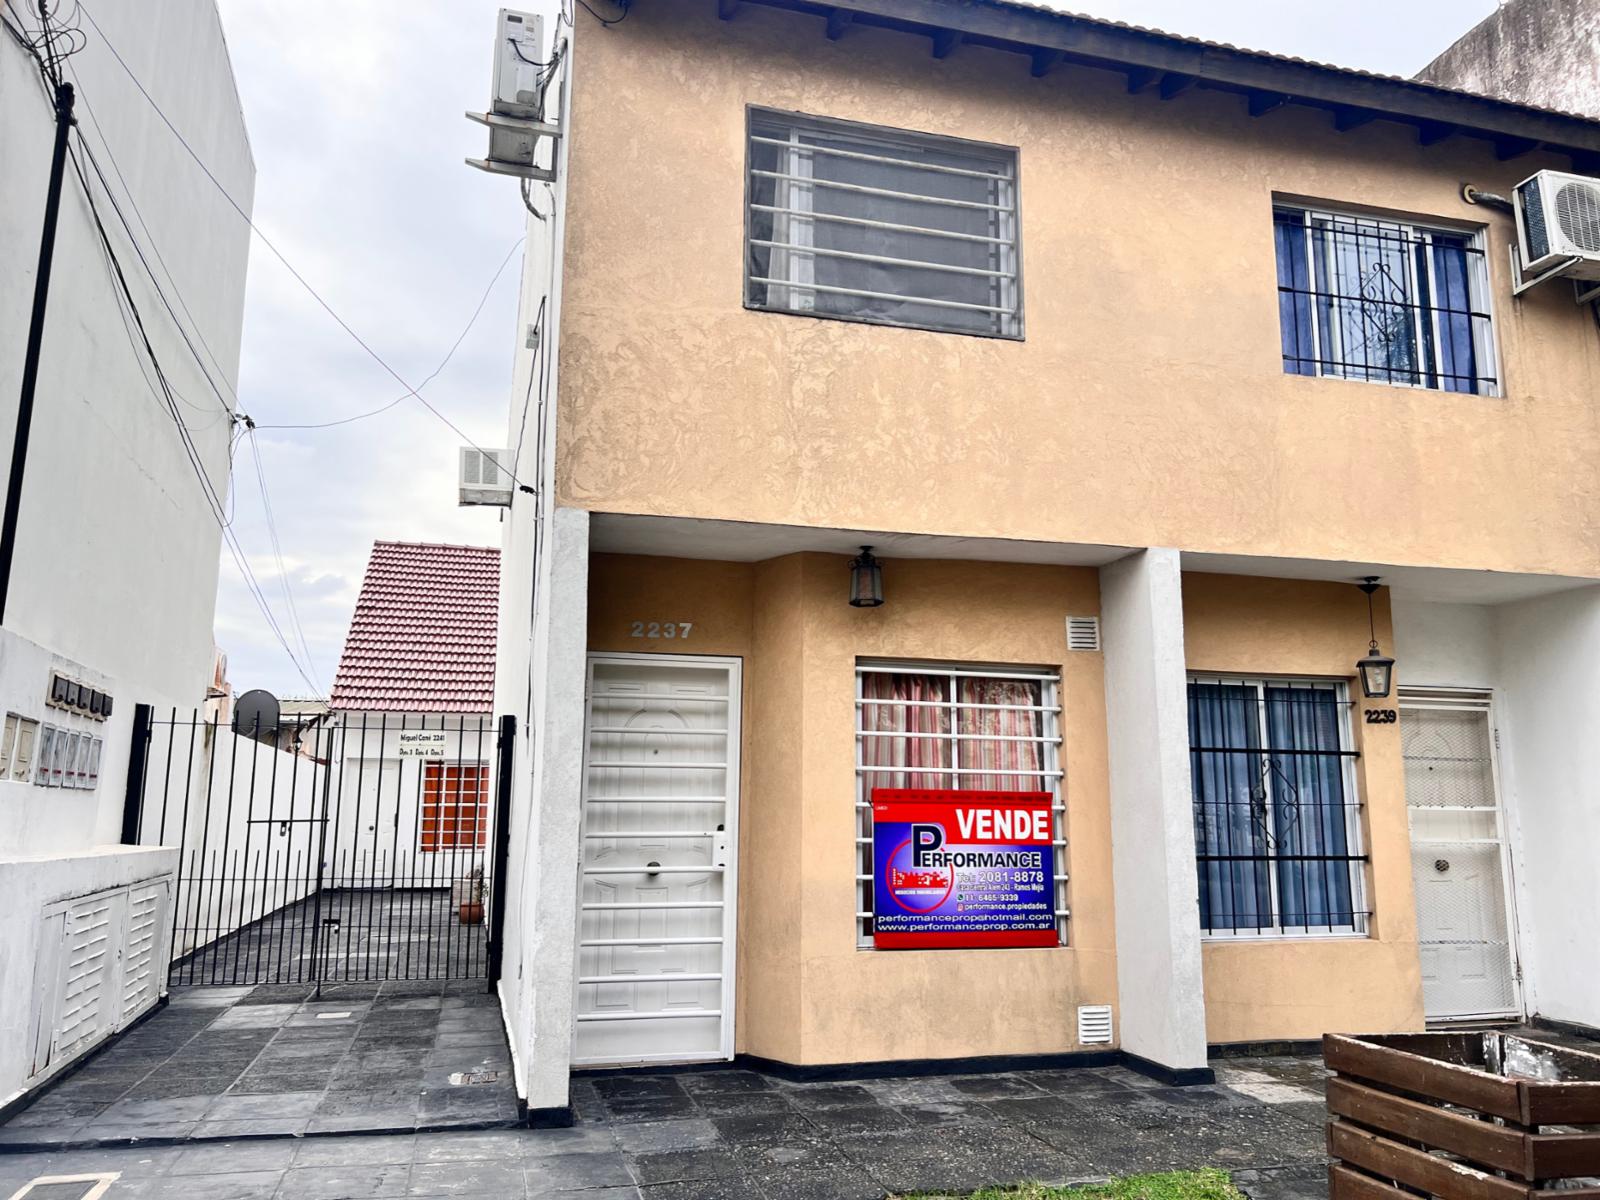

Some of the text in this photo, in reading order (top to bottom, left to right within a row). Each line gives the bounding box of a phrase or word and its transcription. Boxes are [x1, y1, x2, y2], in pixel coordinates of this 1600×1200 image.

[631, 621, 692, 639] 2237
[1364, 709, 1397, 724] 2239
[400, 734, 417, 742] Miguel
[955, 808, 1049, 840] VENDE
[911, 823, 1042, 868] PERFORMANCE
[979, 871, 1044, 882] 2081-8878
[965, 902, 1048, 911] performance.propiedades
[877, 913, 1053, 923] performanceprop@hotmail.com
[877, 922, 1051, 931] www.performanceprop.com.ar
